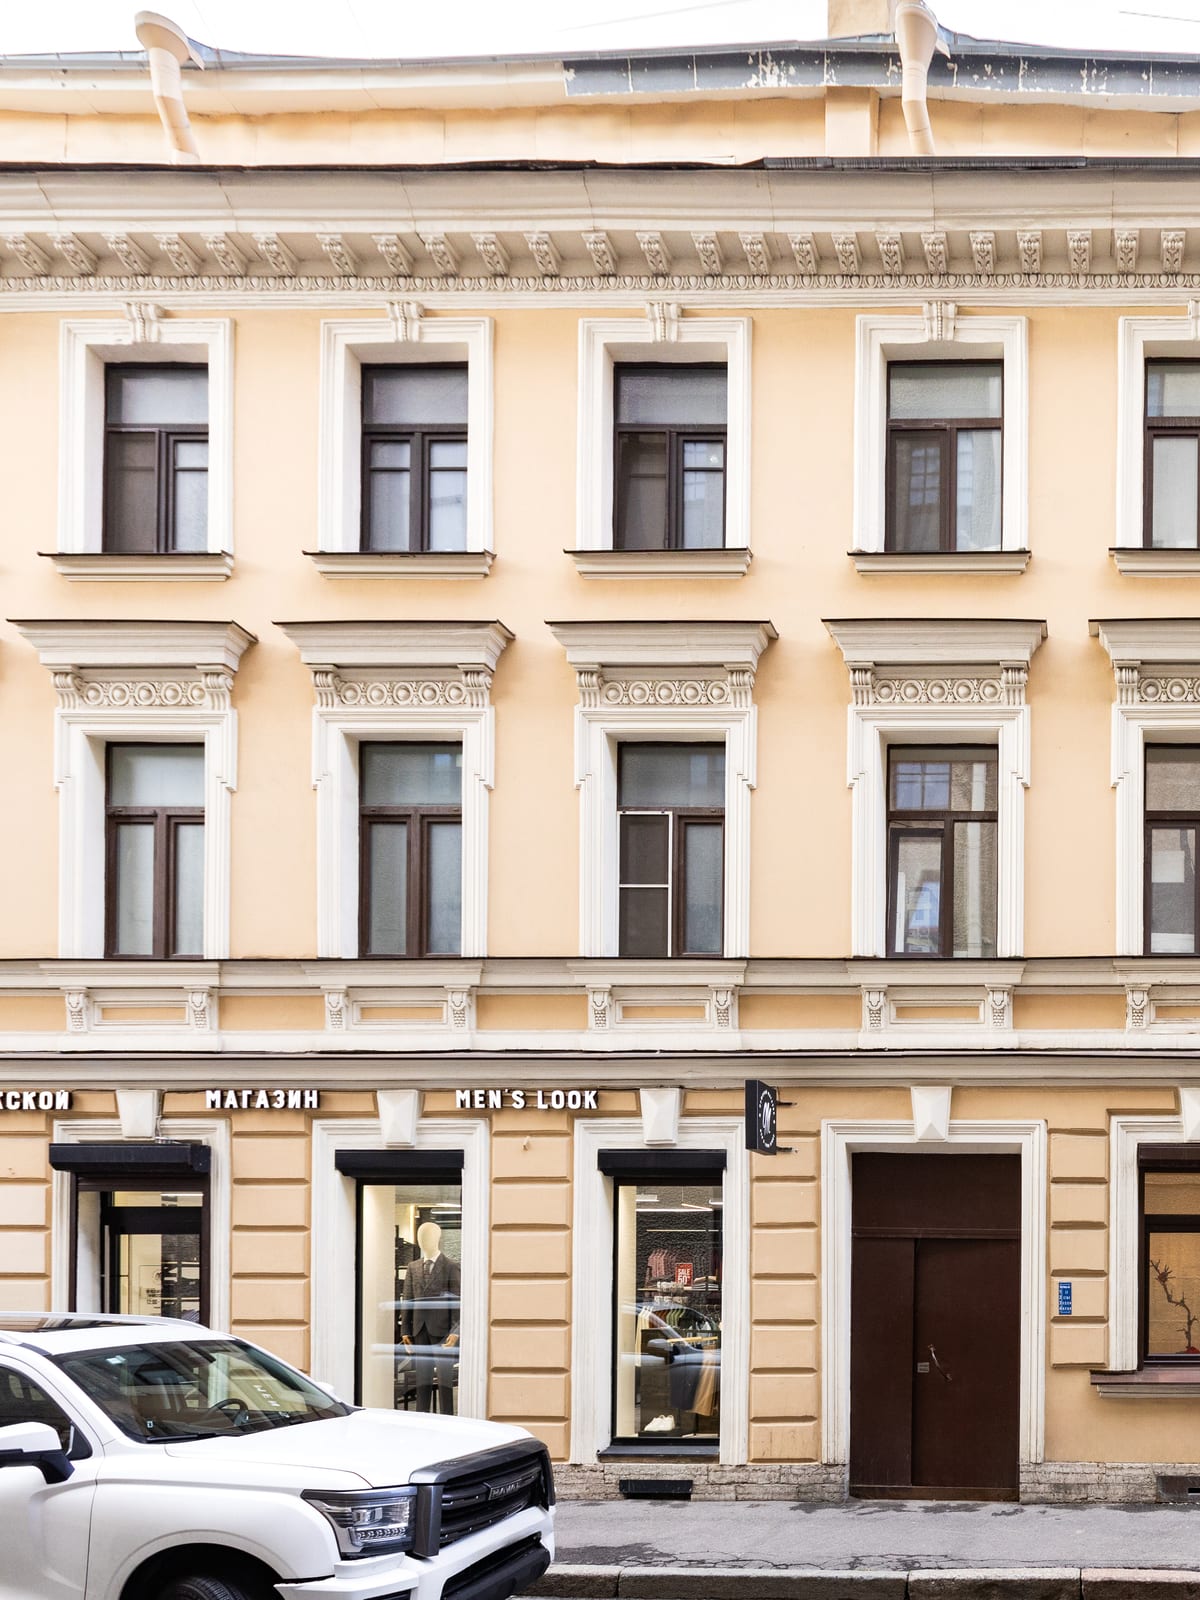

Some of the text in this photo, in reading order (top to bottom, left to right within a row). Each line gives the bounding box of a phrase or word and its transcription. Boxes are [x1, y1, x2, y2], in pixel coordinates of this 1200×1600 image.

[0, 1089, 318, 1110] СКОЙ МАГАЗИН
[455, 1088, 598, 1110] MEN'S LOOK
